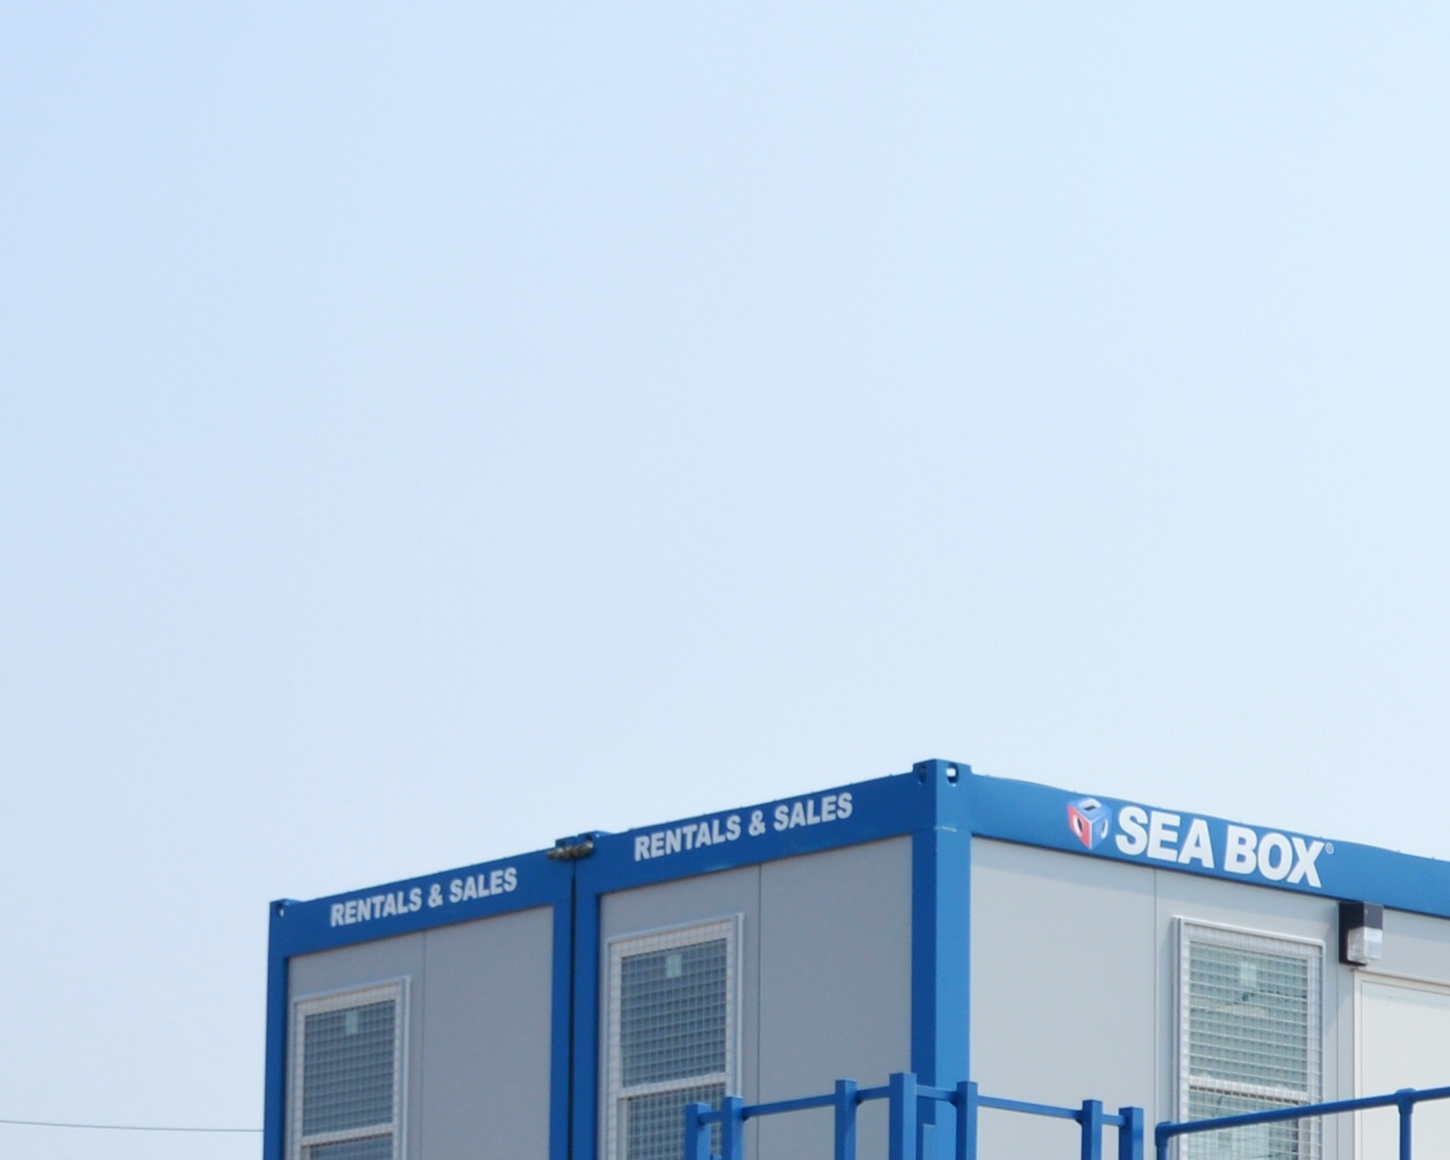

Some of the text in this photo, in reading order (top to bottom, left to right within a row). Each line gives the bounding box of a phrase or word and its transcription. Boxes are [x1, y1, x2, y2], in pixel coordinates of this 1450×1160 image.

[633, 792, 853, 861] RENTALS & SALES
[1115, 805, 1324, 888] SEA BOX
[330, 867, 518, 927] RENTALS & SALES
